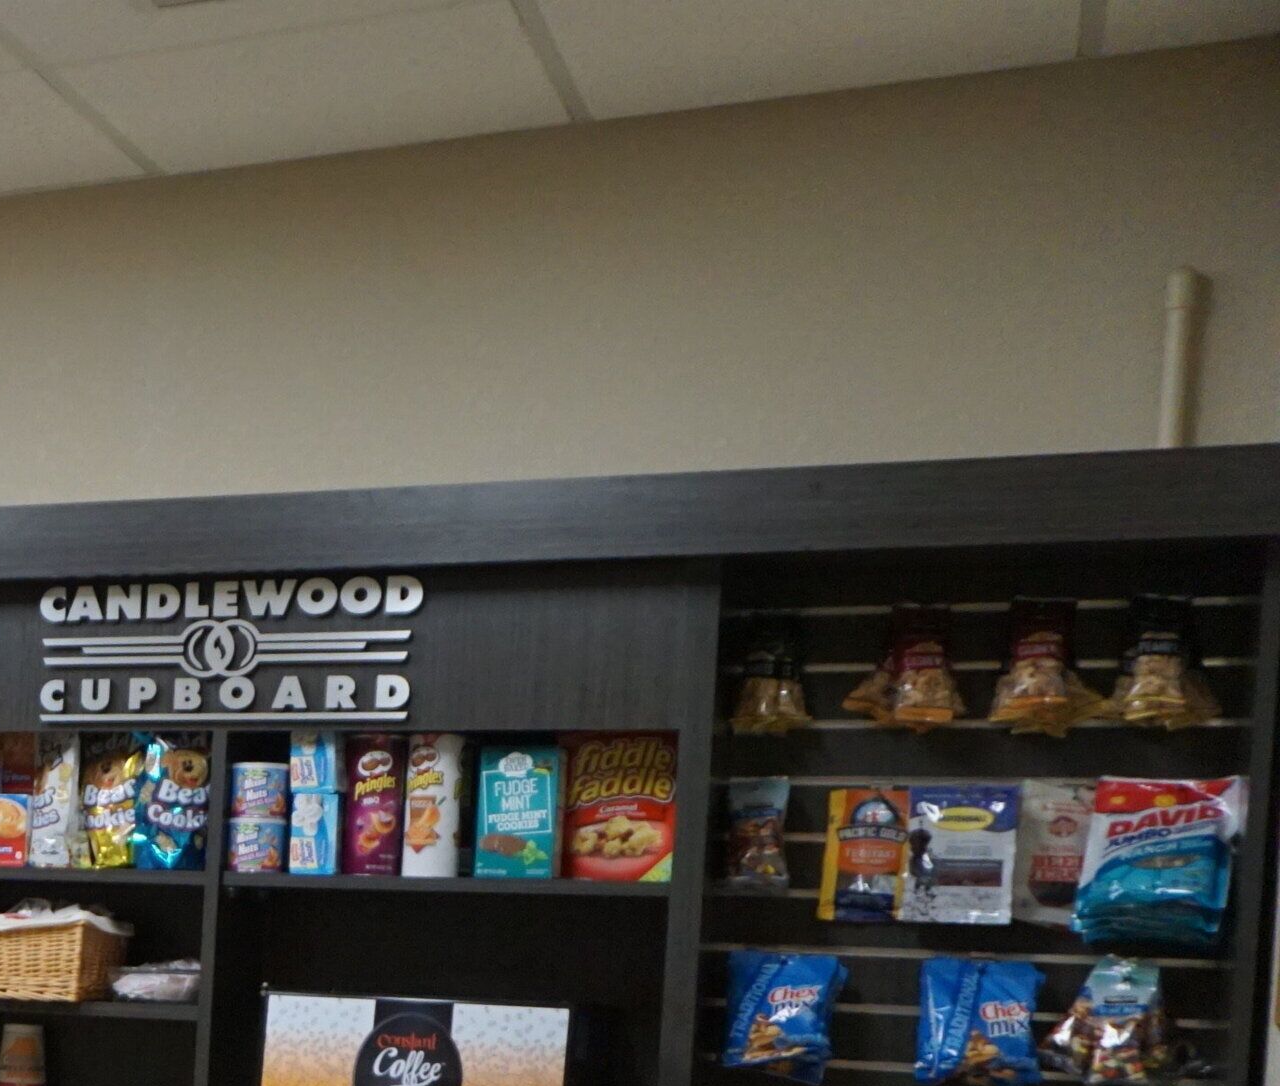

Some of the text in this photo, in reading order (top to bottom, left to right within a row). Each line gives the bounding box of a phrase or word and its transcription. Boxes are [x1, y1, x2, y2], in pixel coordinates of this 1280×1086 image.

[40, 574, 424, 623] CANDLEWOOD
[40, 674, 411, 713] CUPBOARD
[577, 738, 674, 774] fiddle
[354, 773, 396, 800] Pringles
[493, 777, 539, 797] FUDGE
[568, 770, 673, 810] faddle
[500, 796, 531, 812] MINT
[487, 811, 520, 824] FUDGE
[496, 819, 540, 831] COOKIES
[1107, 805, 1225, 838] DAVID
[768, 985, 823, 1004] Chex
[980, 1000, 1031, 1022] Chex
[988, 1019, 1030, 1038] mix
